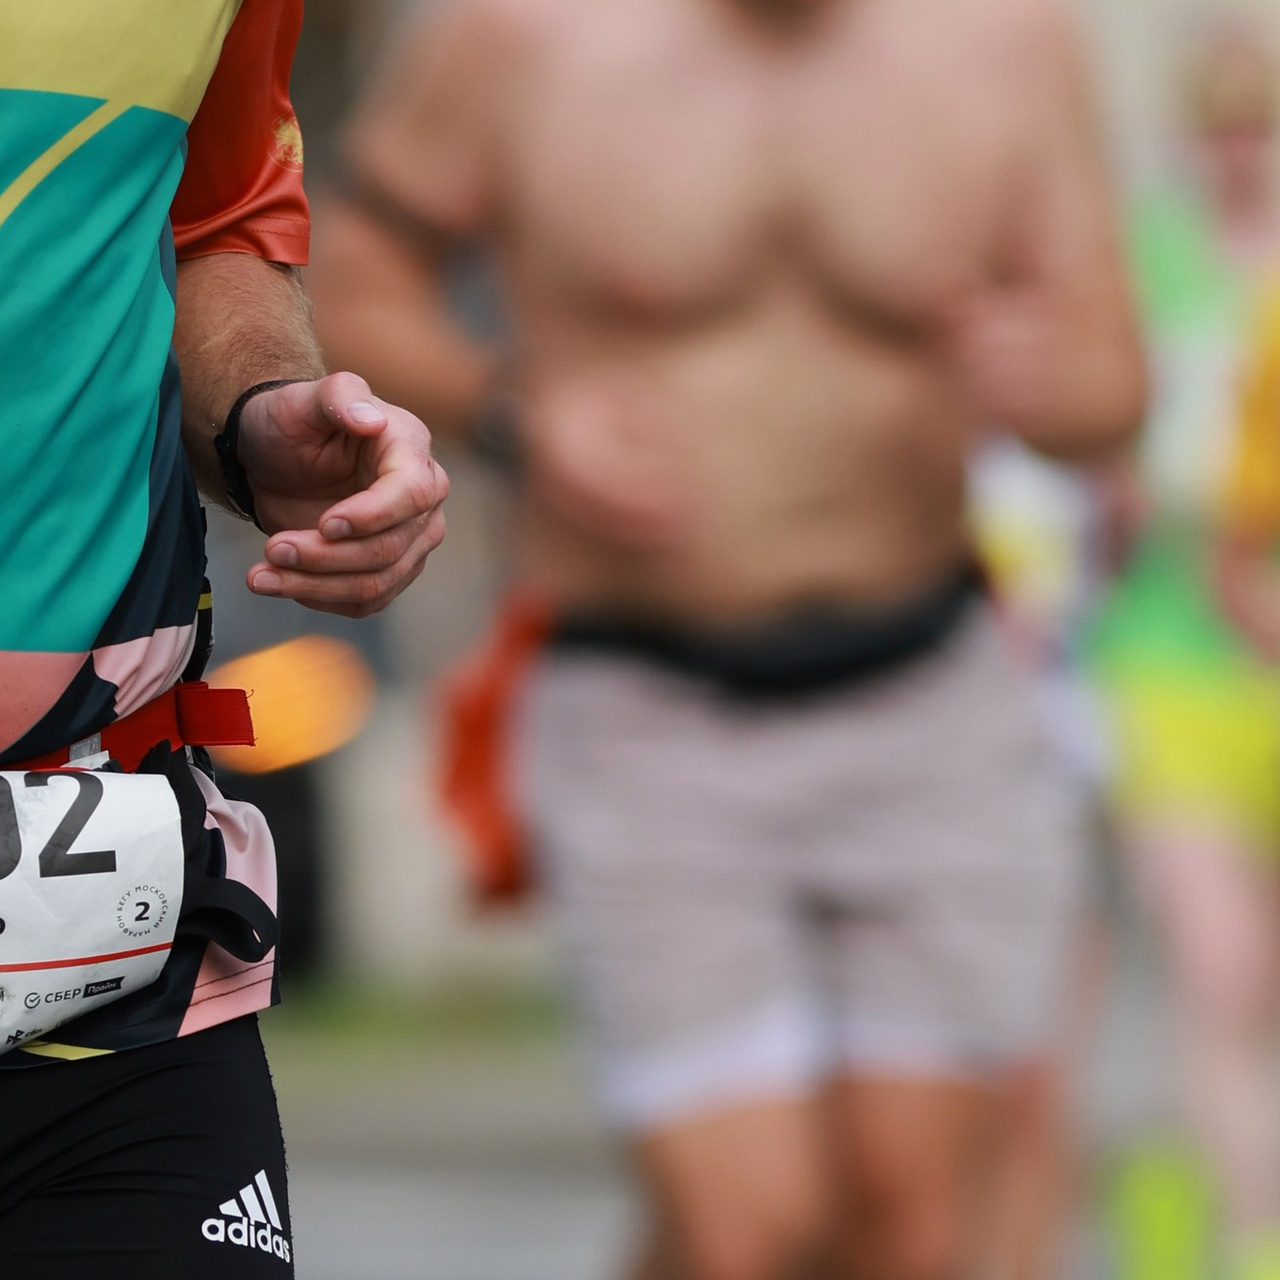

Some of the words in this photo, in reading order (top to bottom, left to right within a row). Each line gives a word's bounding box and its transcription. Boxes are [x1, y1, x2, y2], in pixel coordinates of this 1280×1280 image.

[116, 890, 132, 912] БЕГУ
[134, 884, 169, 929] МОСКОВСКИЙ
[134, 901, 151, 922] 2
[116, 915, 151, 938] МАРАФОН
[44, 988, 82, 1005] СБЕР
[86, 981, 118, 996] Прайм
[201, 1215, 291, 1264] adidas
